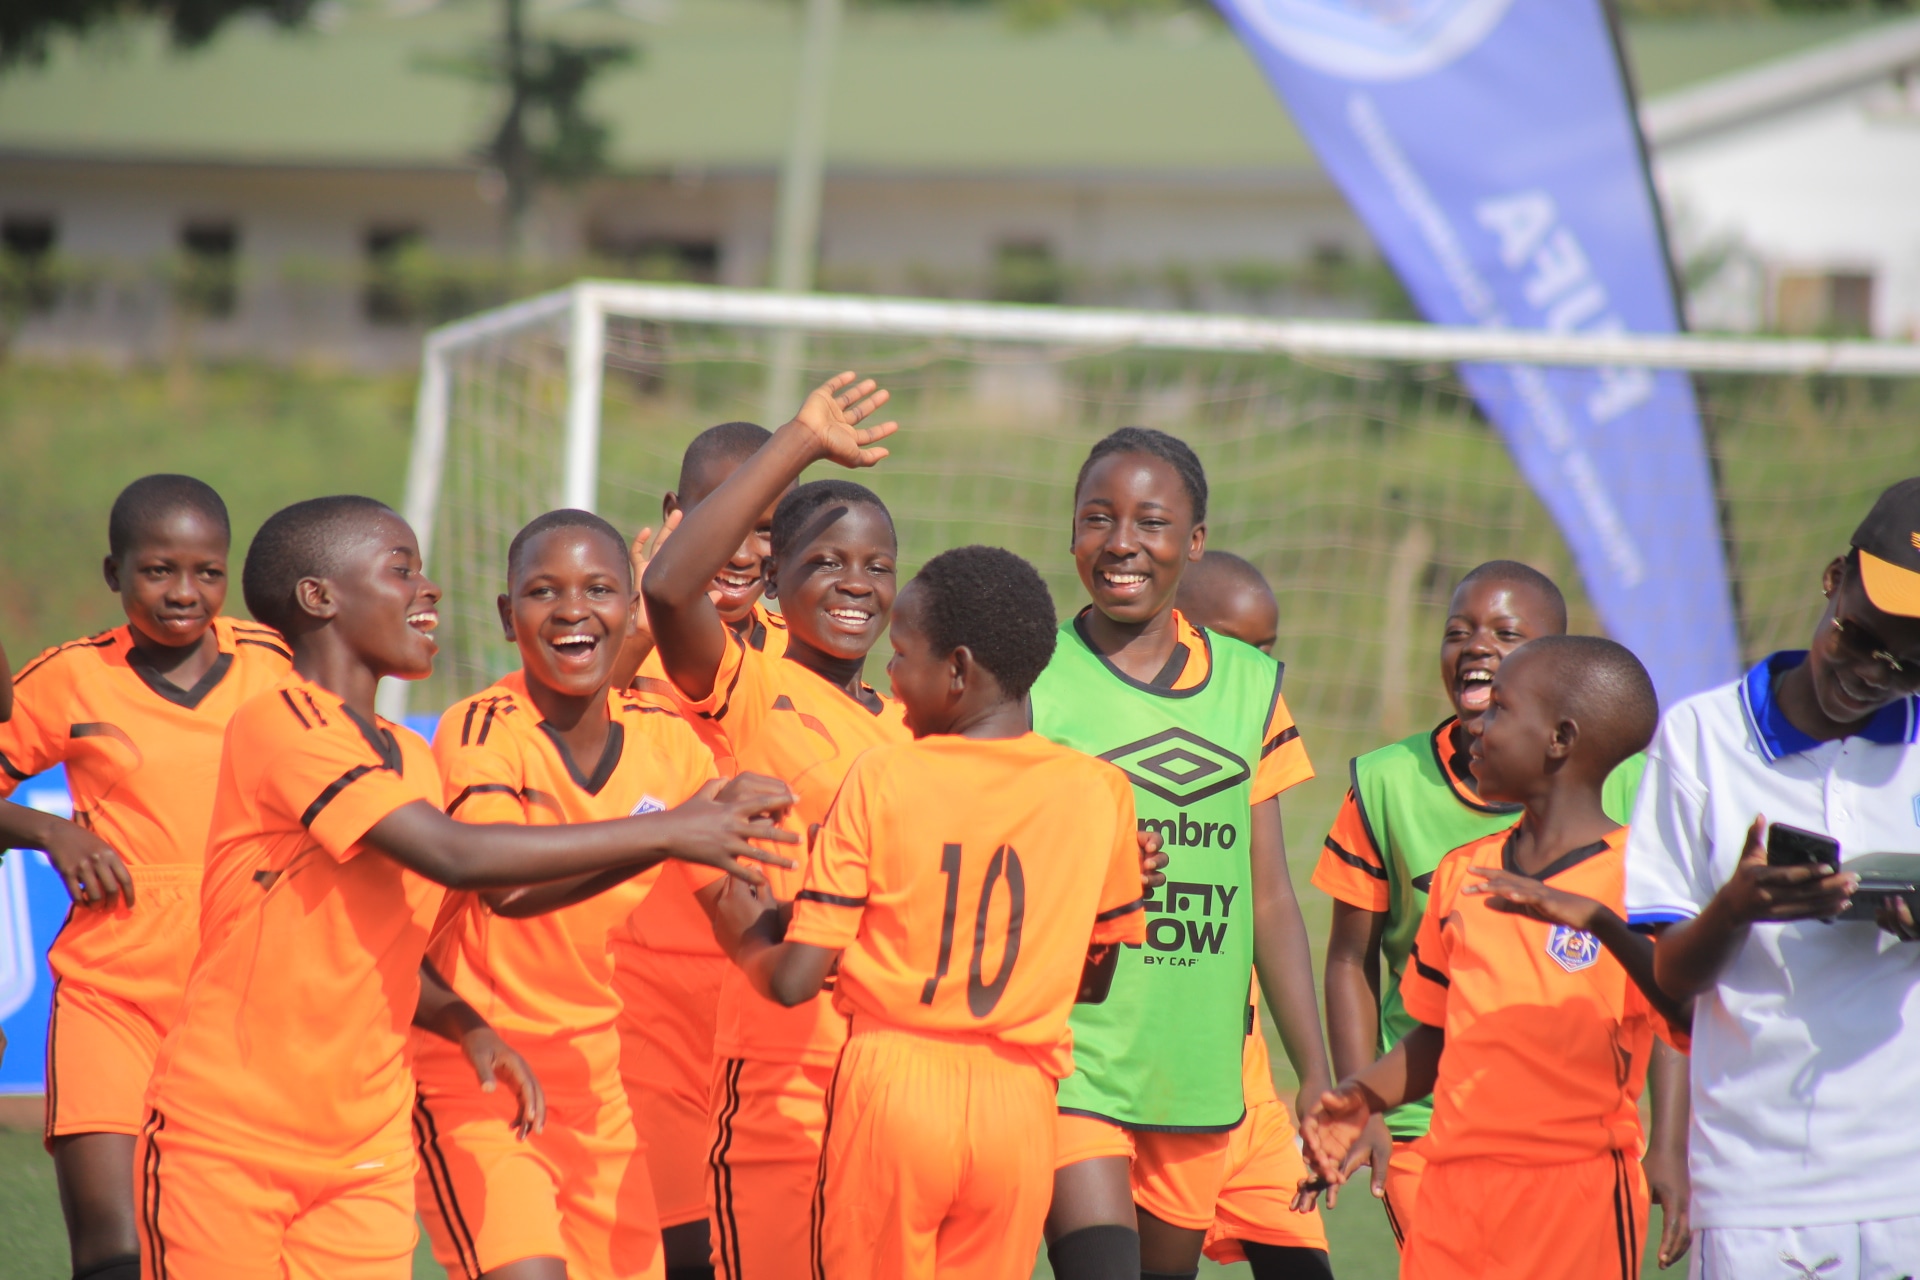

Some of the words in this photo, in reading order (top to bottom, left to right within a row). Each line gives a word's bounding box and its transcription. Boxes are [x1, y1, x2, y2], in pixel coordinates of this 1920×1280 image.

[1137, 812, 1237, 850] mbro
[919, 843, 1025, 1019] 10
[1122, 918, 1228, 955] OW
[1144, 956, 1165, 965] BY
[1170, 957, 1197, 967] CAF
